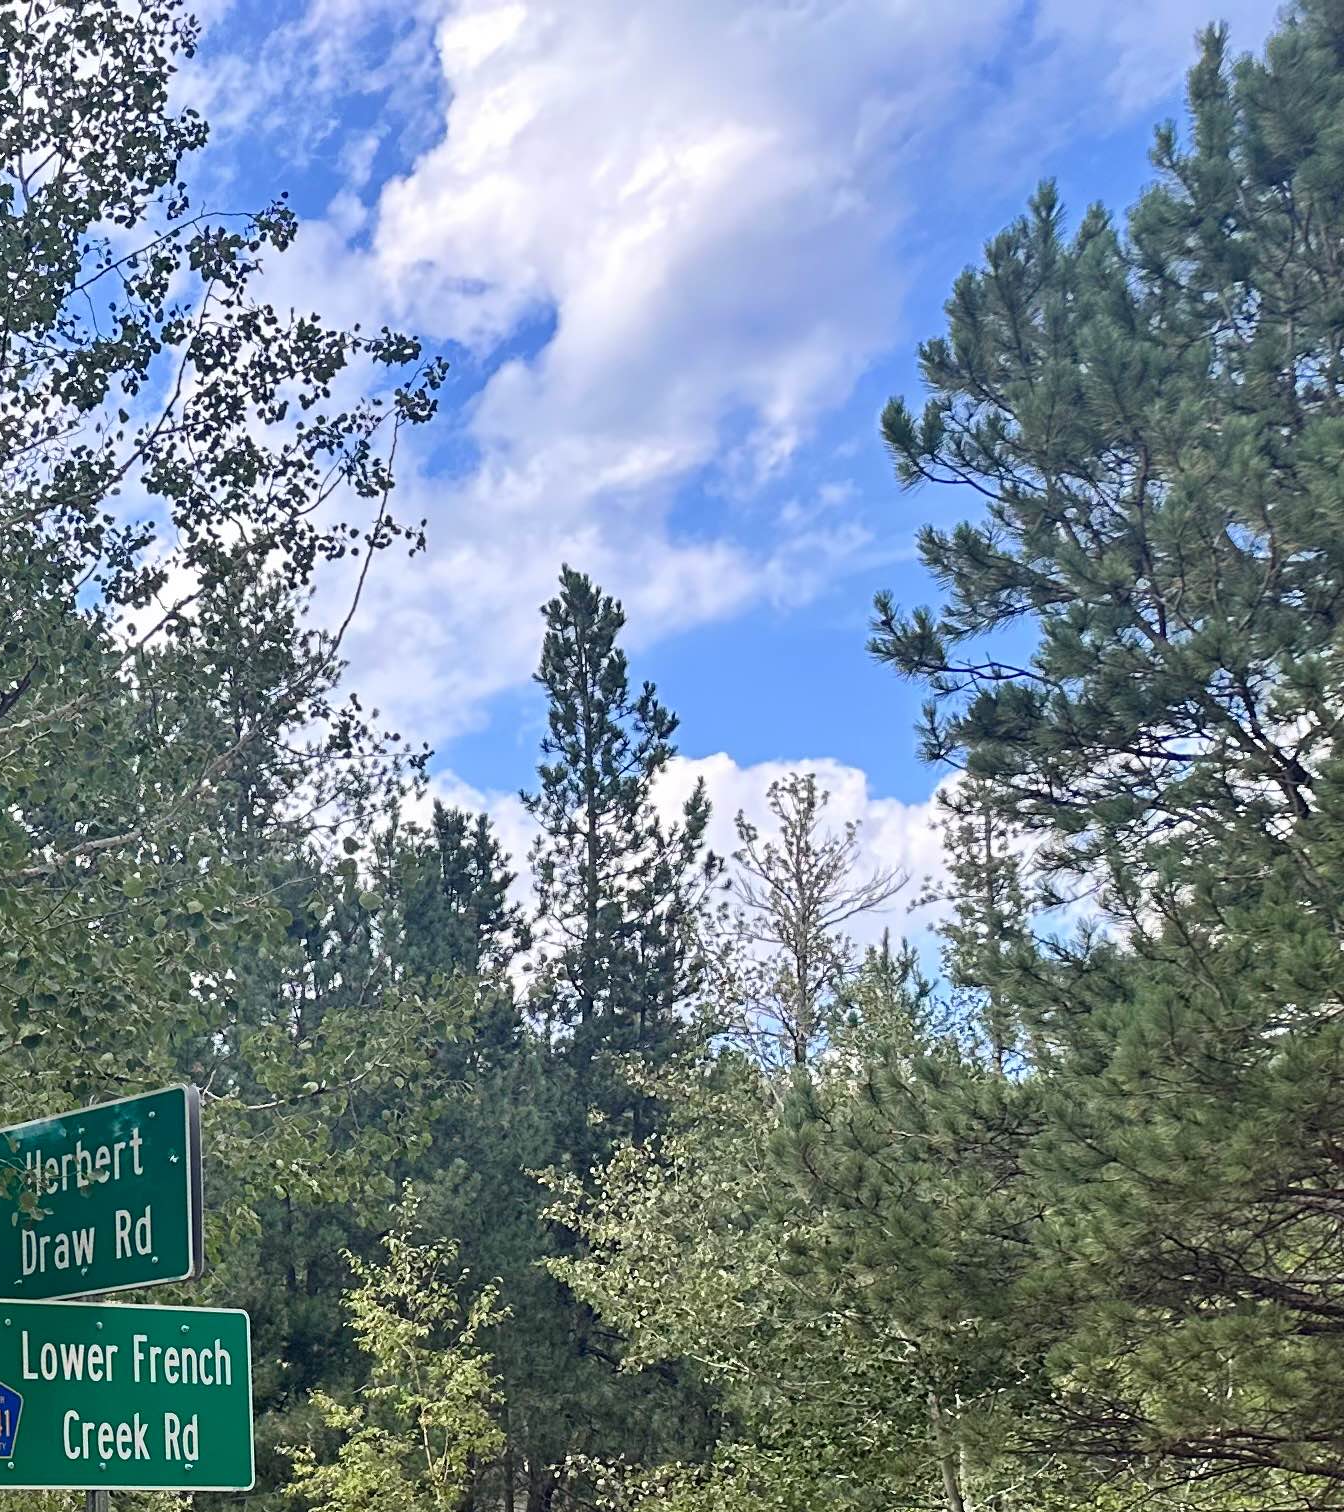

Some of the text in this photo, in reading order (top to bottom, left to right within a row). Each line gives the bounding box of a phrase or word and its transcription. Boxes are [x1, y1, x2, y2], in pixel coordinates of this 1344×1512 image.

[25, 1127, 144, 1196] Herbert
[21, 1205, 152, 1276] Draw Rd
[22, 1330, 231, 1386] Lower French
[63, 1410, 198, 1461] Creek Rd
